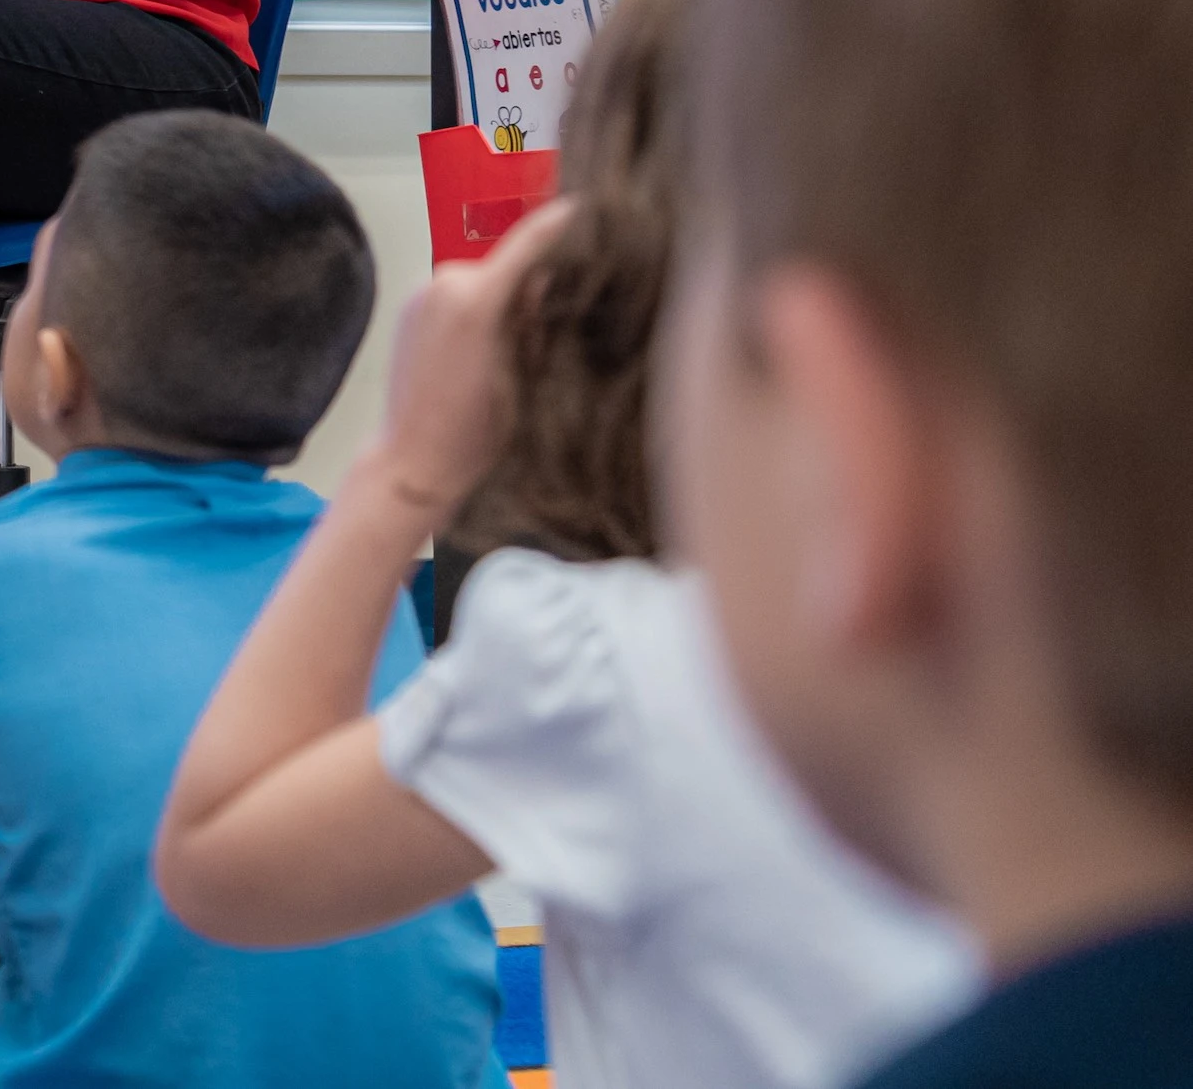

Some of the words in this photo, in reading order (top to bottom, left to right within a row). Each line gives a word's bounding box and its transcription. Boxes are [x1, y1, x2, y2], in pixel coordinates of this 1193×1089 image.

[502, 25, 563, 51] abiertas
[495, 64, 509, 94] a
[529, 64, 544, 90] e
